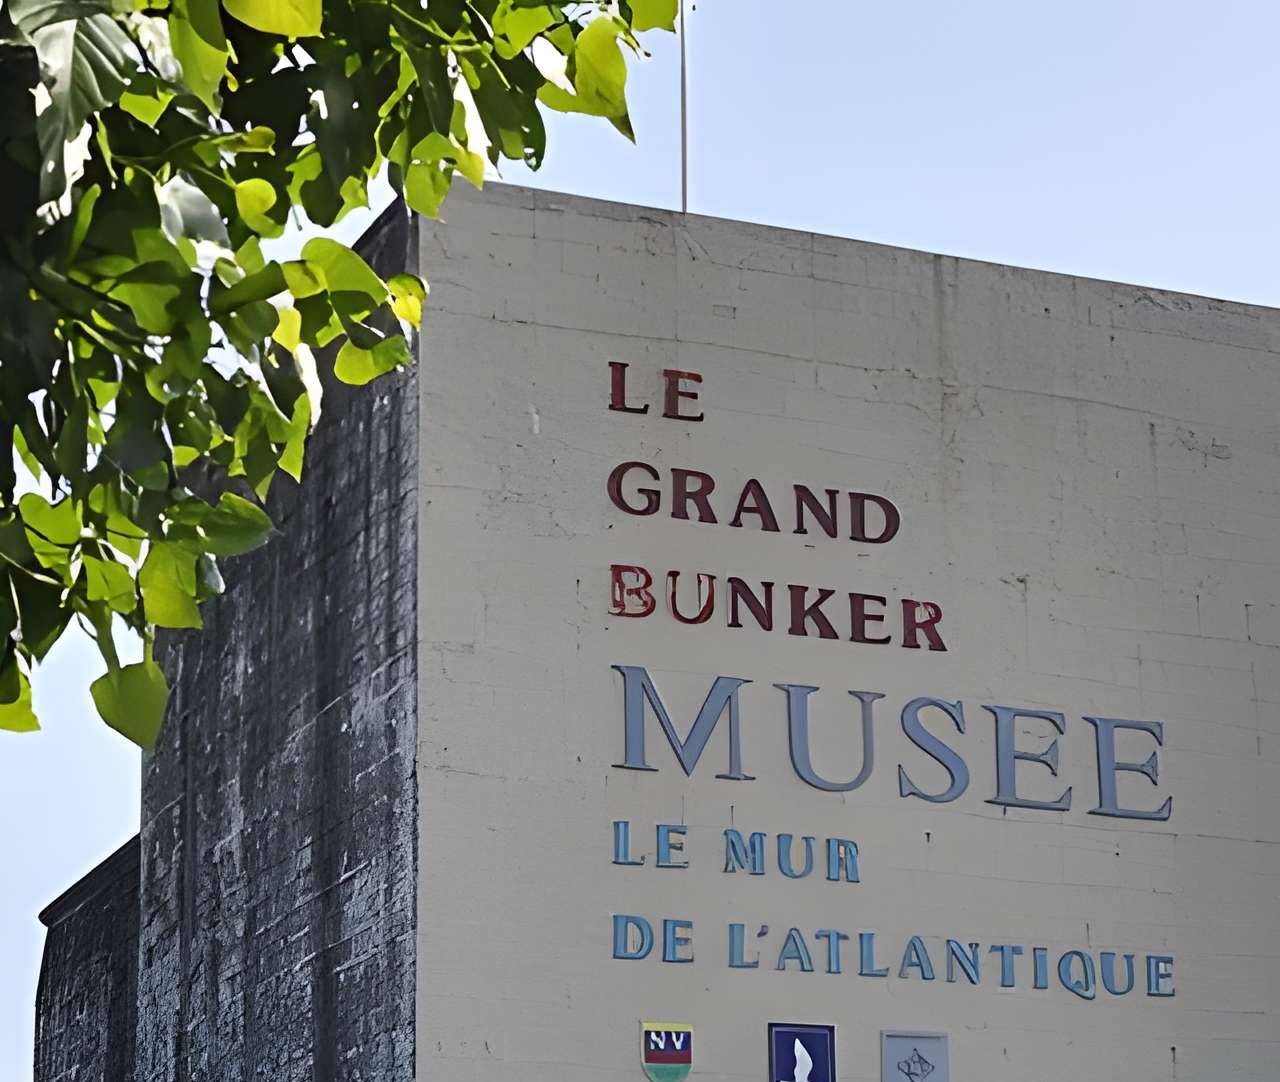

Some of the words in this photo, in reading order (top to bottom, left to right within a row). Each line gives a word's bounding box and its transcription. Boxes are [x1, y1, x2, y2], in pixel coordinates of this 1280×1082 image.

[607, 360, 705, 422] LE
[606, 460, 901, 545] GRAND
[607, 564, 948, 652] BUNKER
[610, 664, 1172, 822] MUSEE
[612, 820, 689, 869] LE
[723, 829, 860, 883] MUR
[612, 914, 694, 963] DE
[728, 923, 1175, 1000] L'ATLANTIQUE
